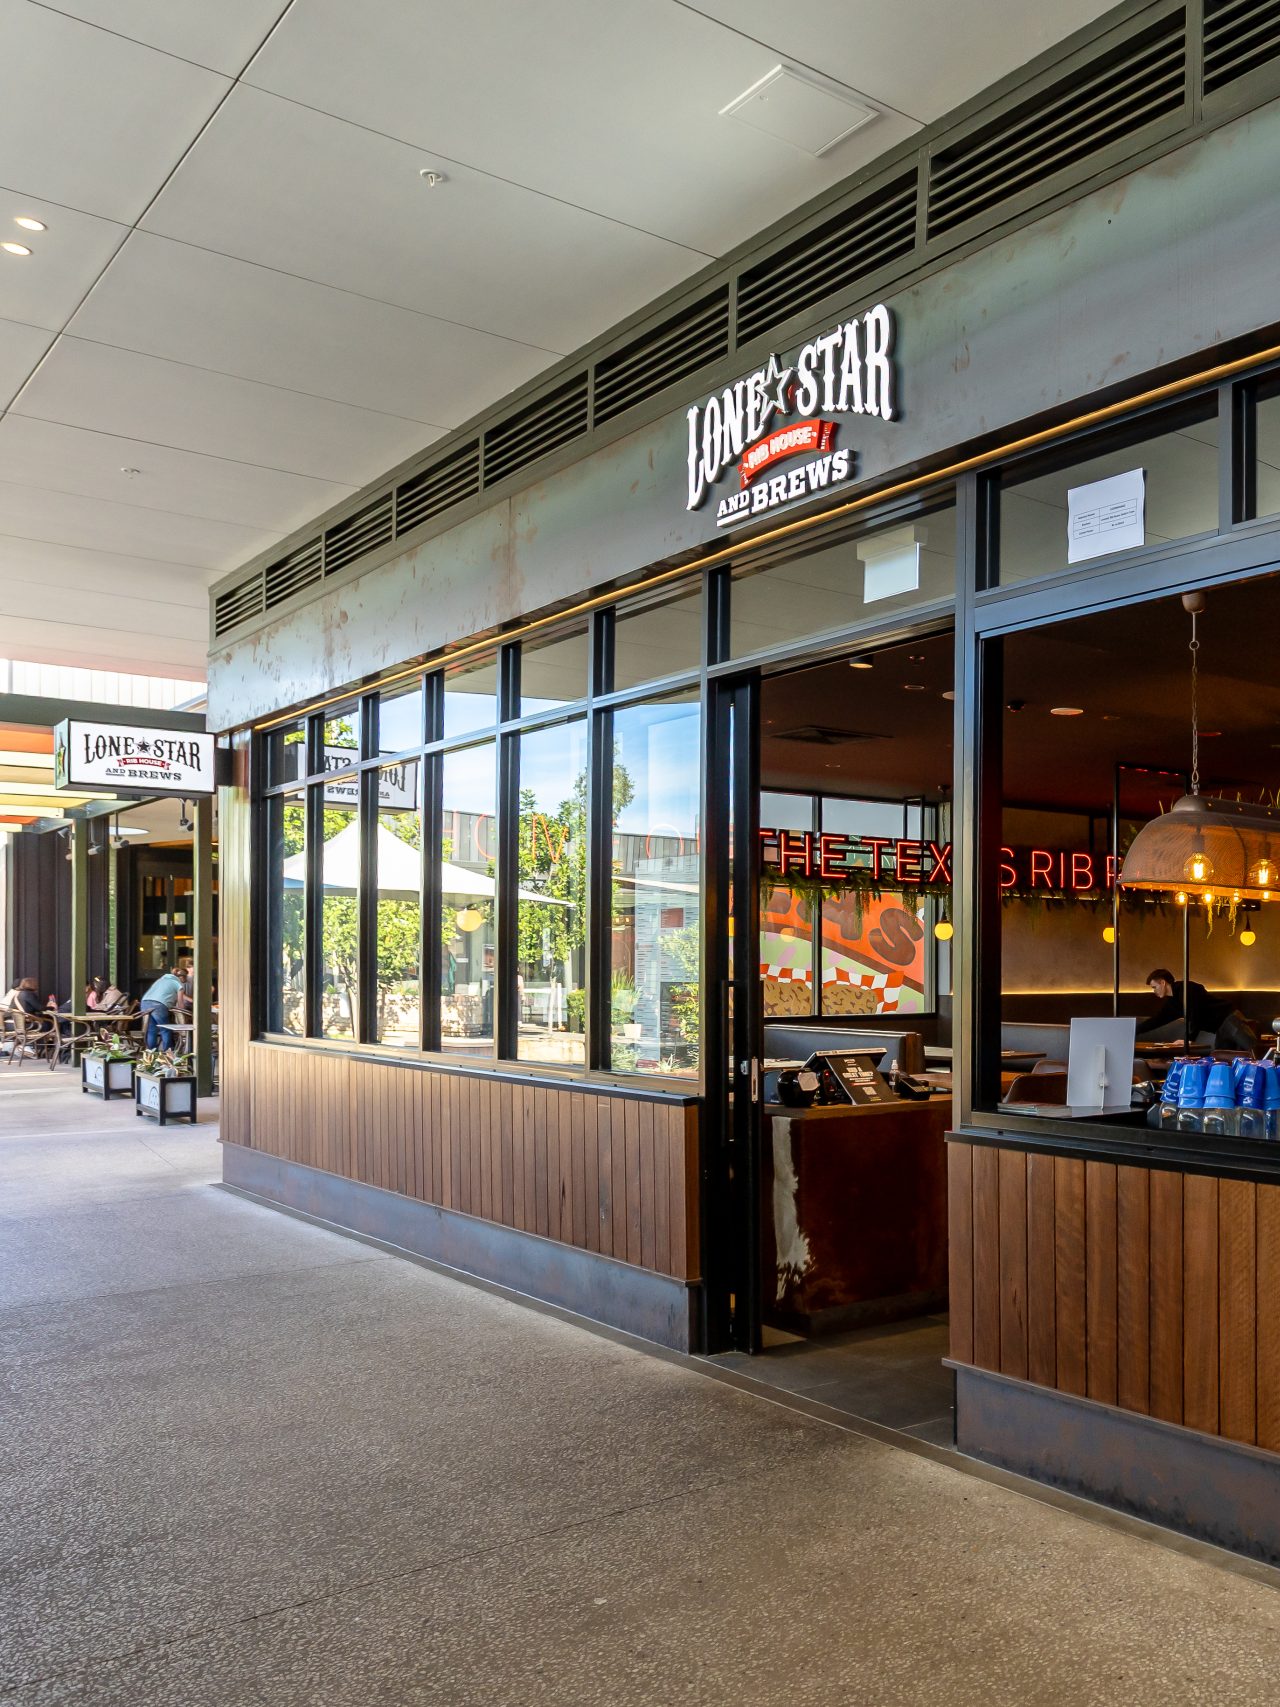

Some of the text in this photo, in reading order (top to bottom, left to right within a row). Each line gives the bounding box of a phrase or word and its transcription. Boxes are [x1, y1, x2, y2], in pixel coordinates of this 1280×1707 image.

[687, 304, 894, 510] LONE STAR
[769, 427, 813, 454] HOUSE
[717, 449, 850, 518] AND BREWS
[84, 733, 202, 771] LONE STAR
[128, 769, 182, 781] BREWS
[861, 838, 1017, 887] TEXS
[1031, 850, 1093, 889] RIB
